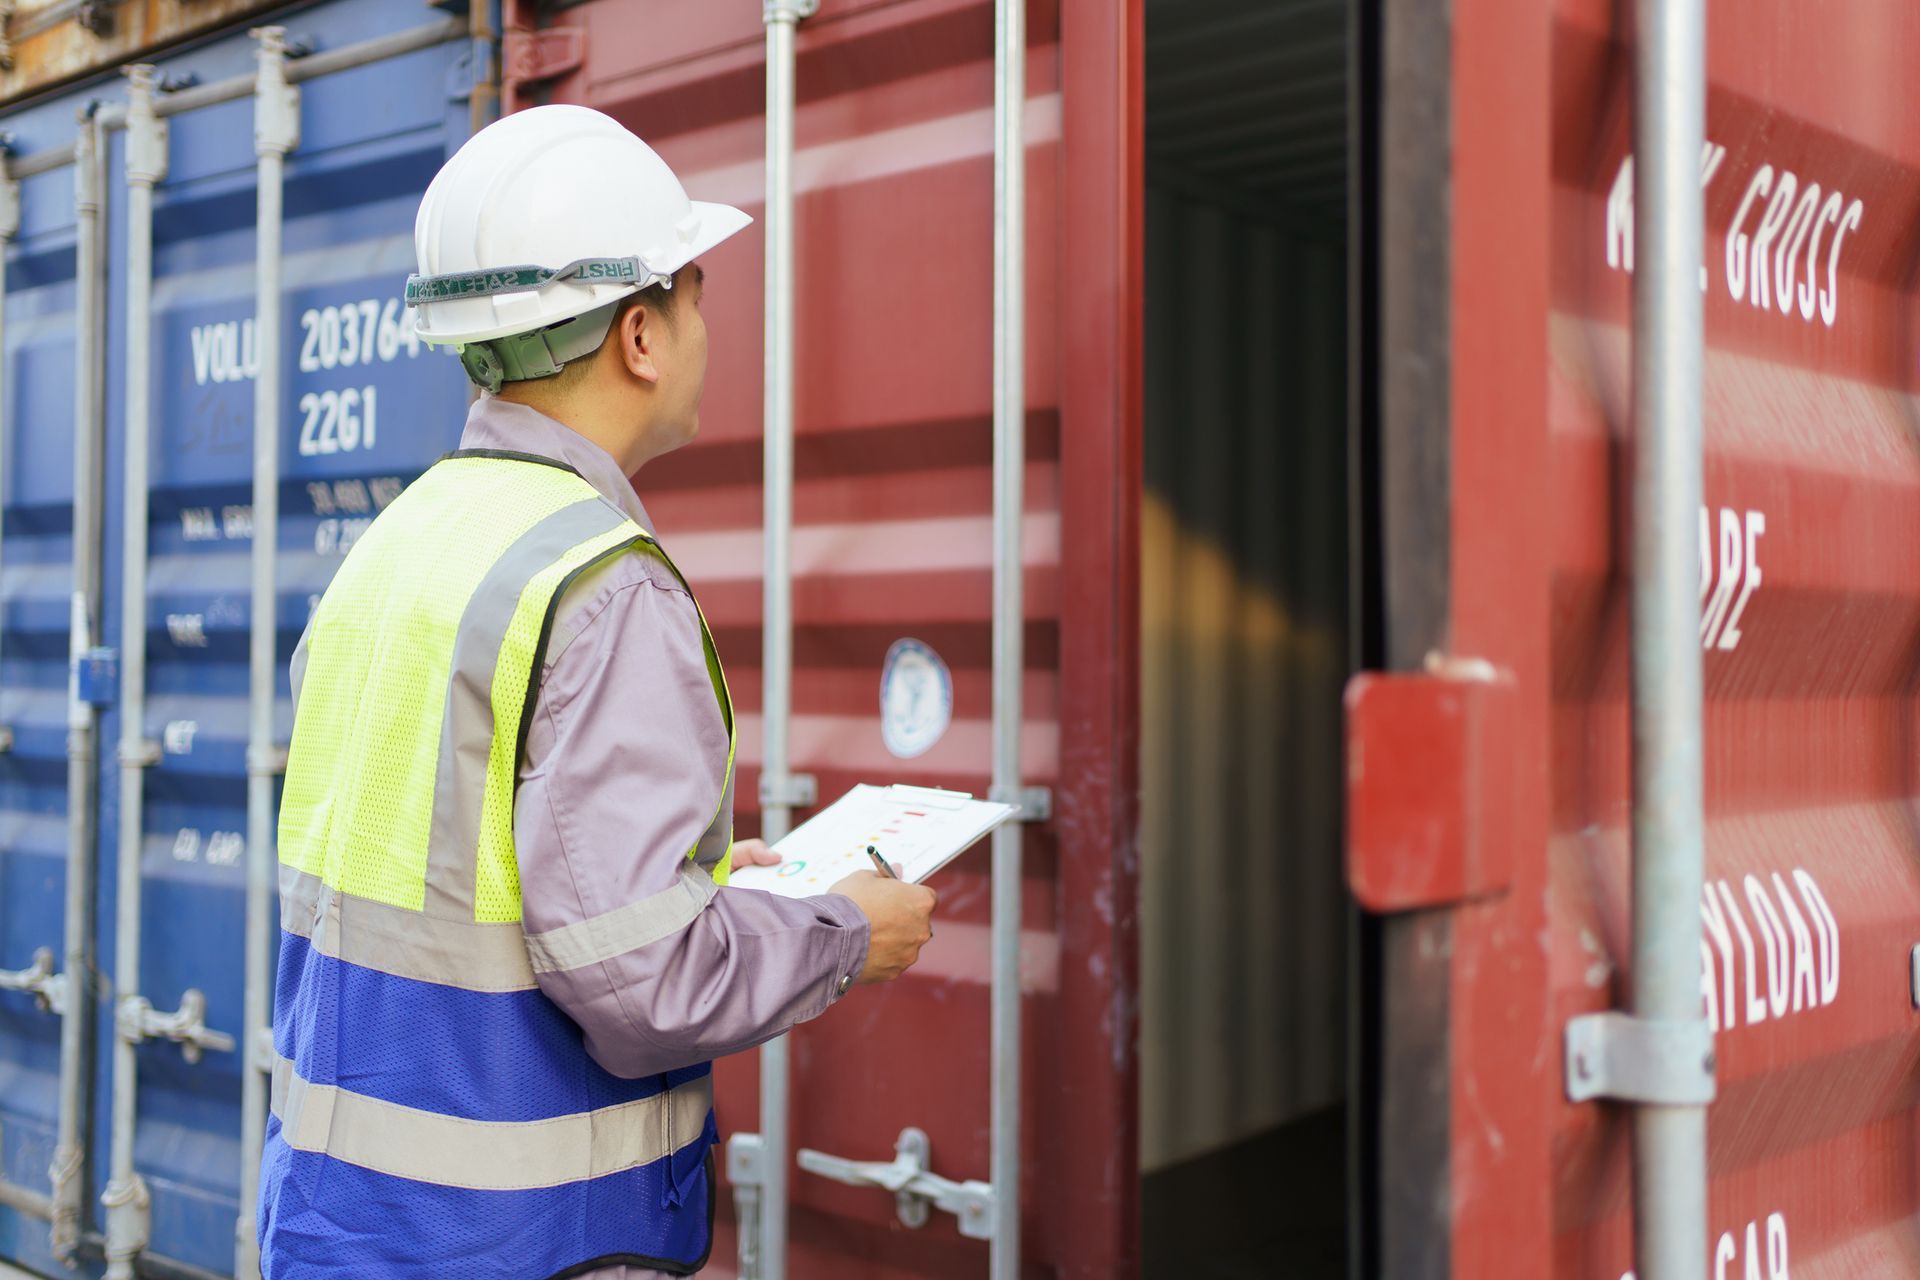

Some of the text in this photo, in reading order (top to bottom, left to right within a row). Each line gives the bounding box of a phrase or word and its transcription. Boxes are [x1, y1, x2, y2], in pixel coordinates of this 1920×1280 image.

[572, 261, 634, 280] FIRST
[1726, 164, 1863, 327] GROSS
[300, 297, 419, 373] 203764
[300, 385, 376, 456] 22G1
[1699, 868, 1840, 1035] AYLOAD
